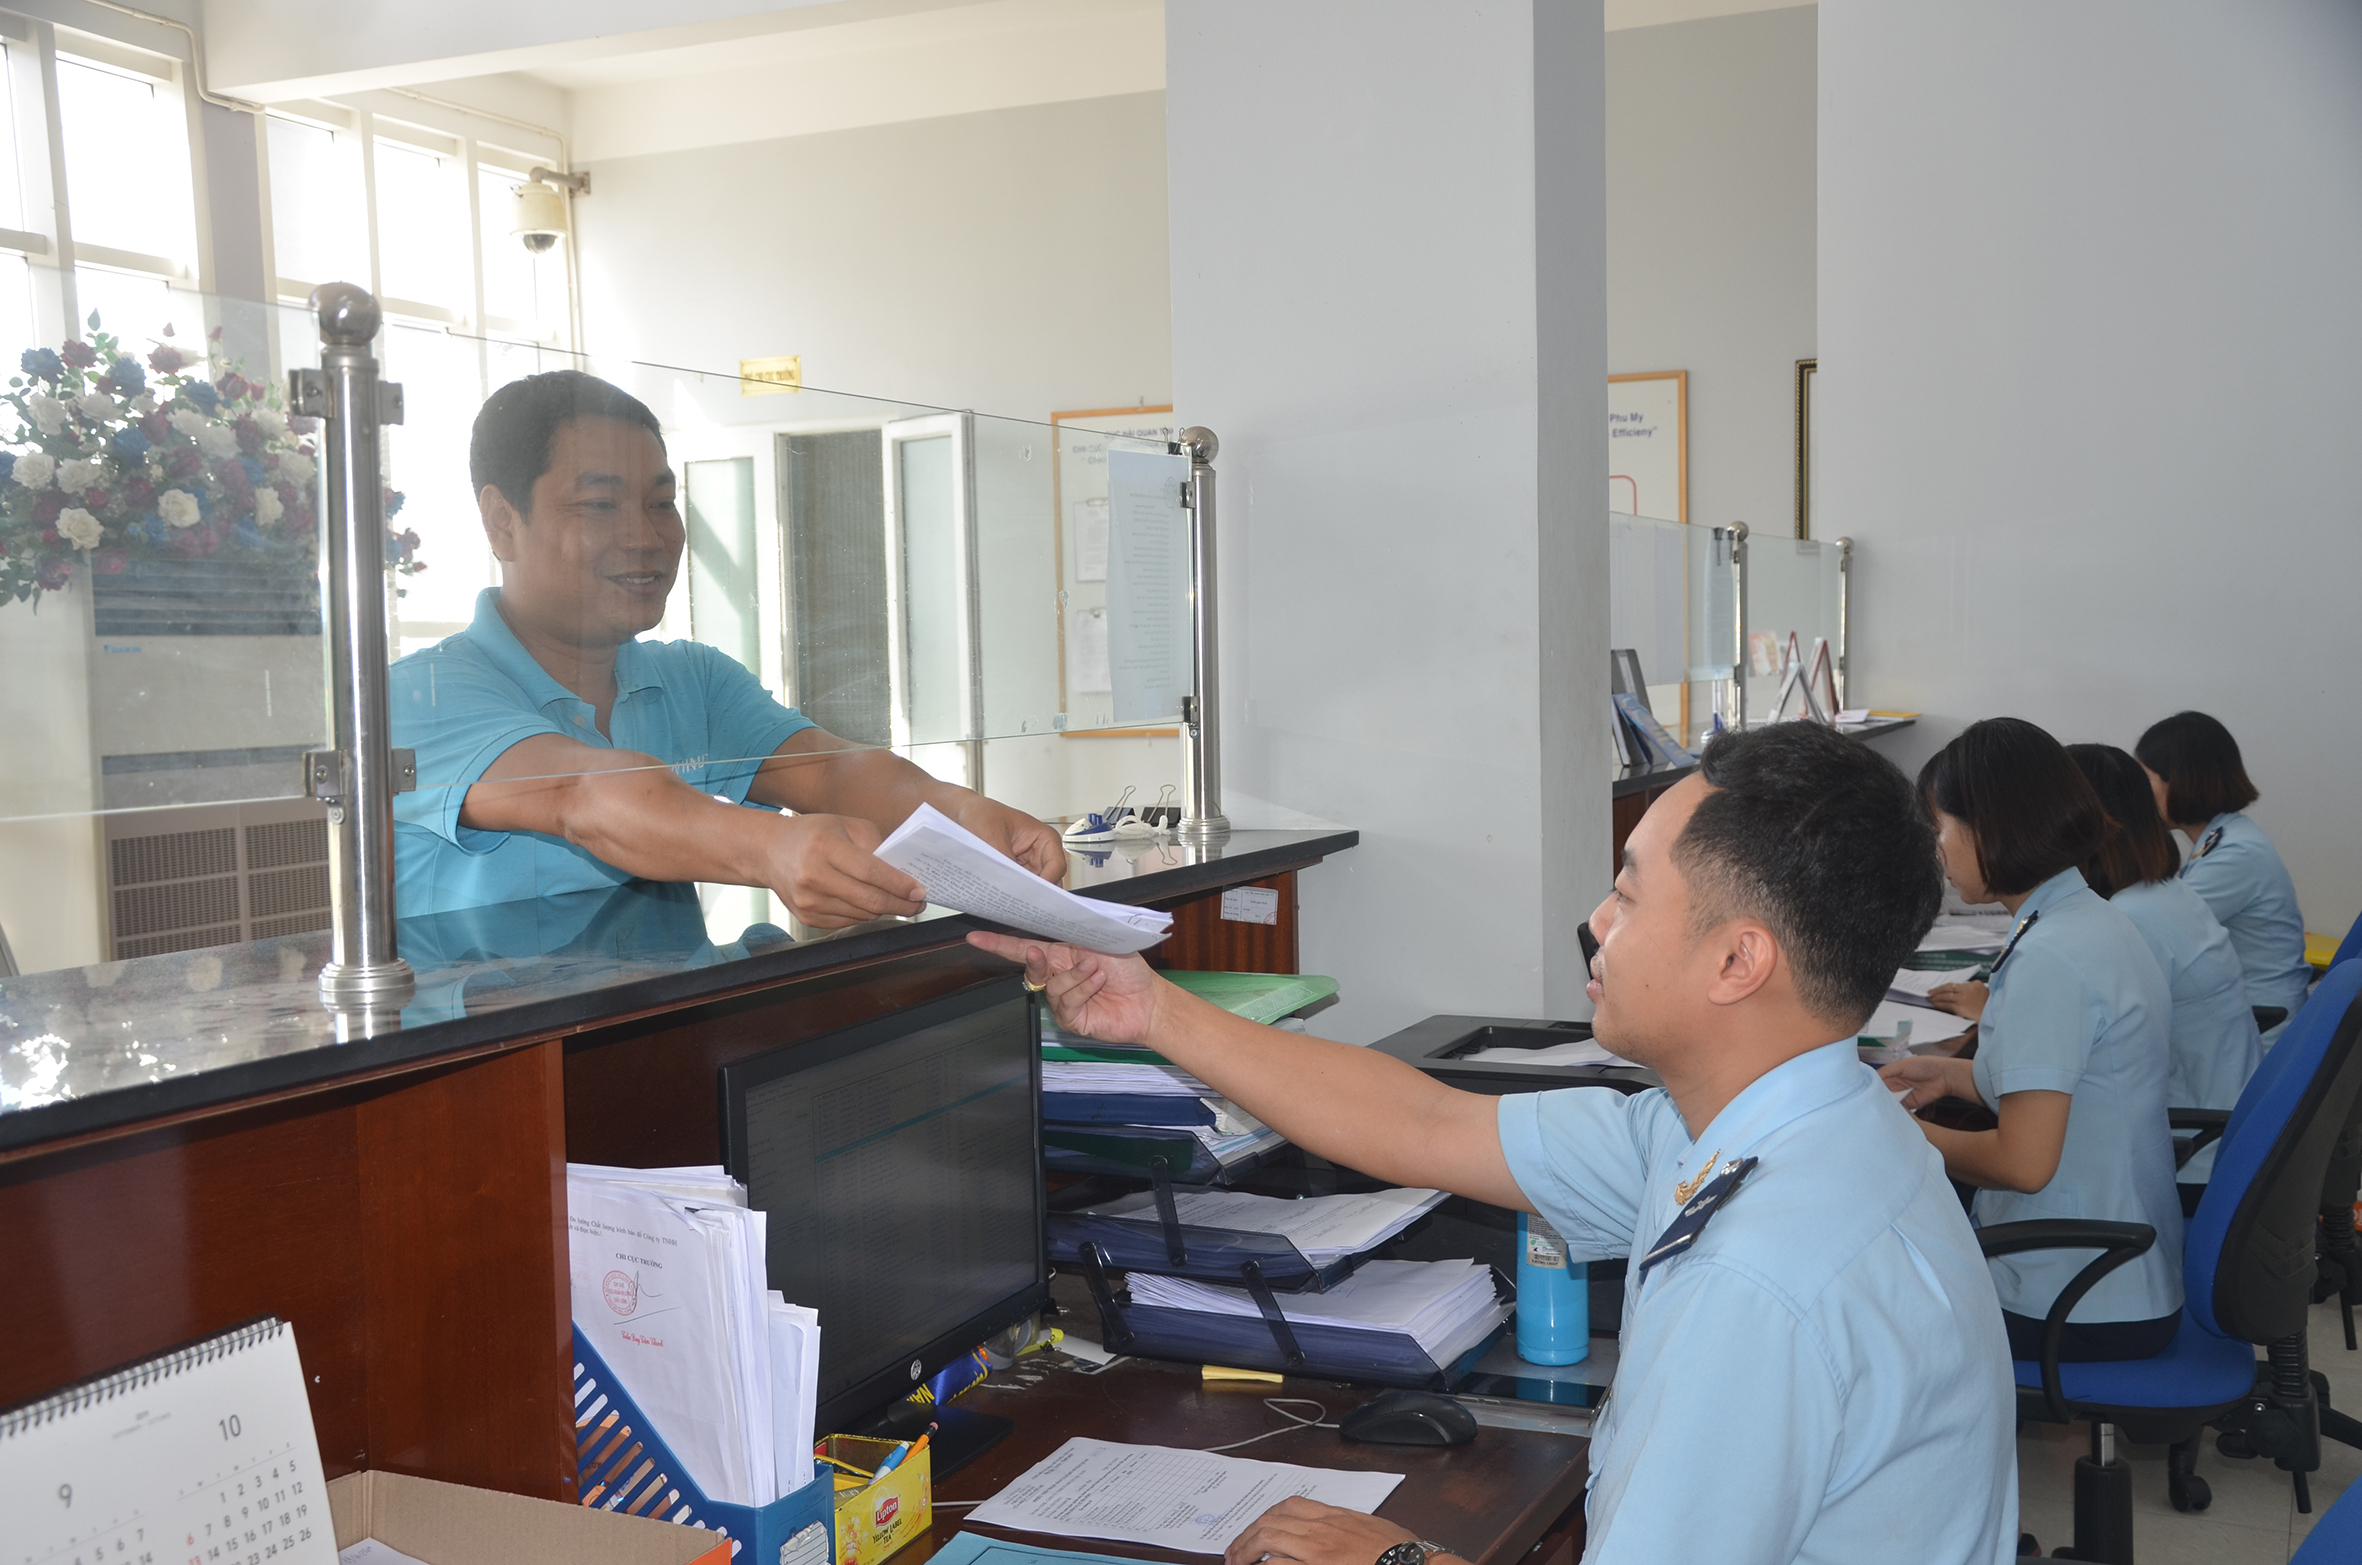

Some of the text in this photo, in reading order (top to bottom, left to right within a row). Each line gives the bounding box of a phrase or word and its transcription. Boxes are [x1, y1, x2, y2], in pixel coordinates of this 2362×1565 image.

[1610, 412, 1644, 424] Phu My
[661, 1236, 678, 1247] TNHH
[615, 1252, 627, 1261] CHI
[627, 1255, 640, 1264] CỤC
[219, 1414, 242, 1442] 10
[219, 1460, 297, 1503] 1 2 3 4 5
[57, 1483, 74, 1510] 9
[186, 1480, 304, 1546] 6 7 8 9 10 11 12
[876, 1501, 898, 1522] Lipton
[95, 1547, 104, 1561] 5
[116, 1538, 126, 1552] 6
[136, 1527, 145, 1542] 7
[207, 1546, 221, 1562] 14
[226, 1537, 239, 1553] 15
[244, 1529, 257, 1544] 16
[262, 1520, 273, 1536] 17
[279, 1512, 292, 1527] 18
[296, 1504, 308, 1519] 19
[265, 1543, 278, 1560] 24
[282, 1535, 296, 1551] 25
[299, 1527, 313, 1543] 26
[872, 1518, 903, 1544] YELLOW LABEL
[882, 1533, 892, 1545] TEA
